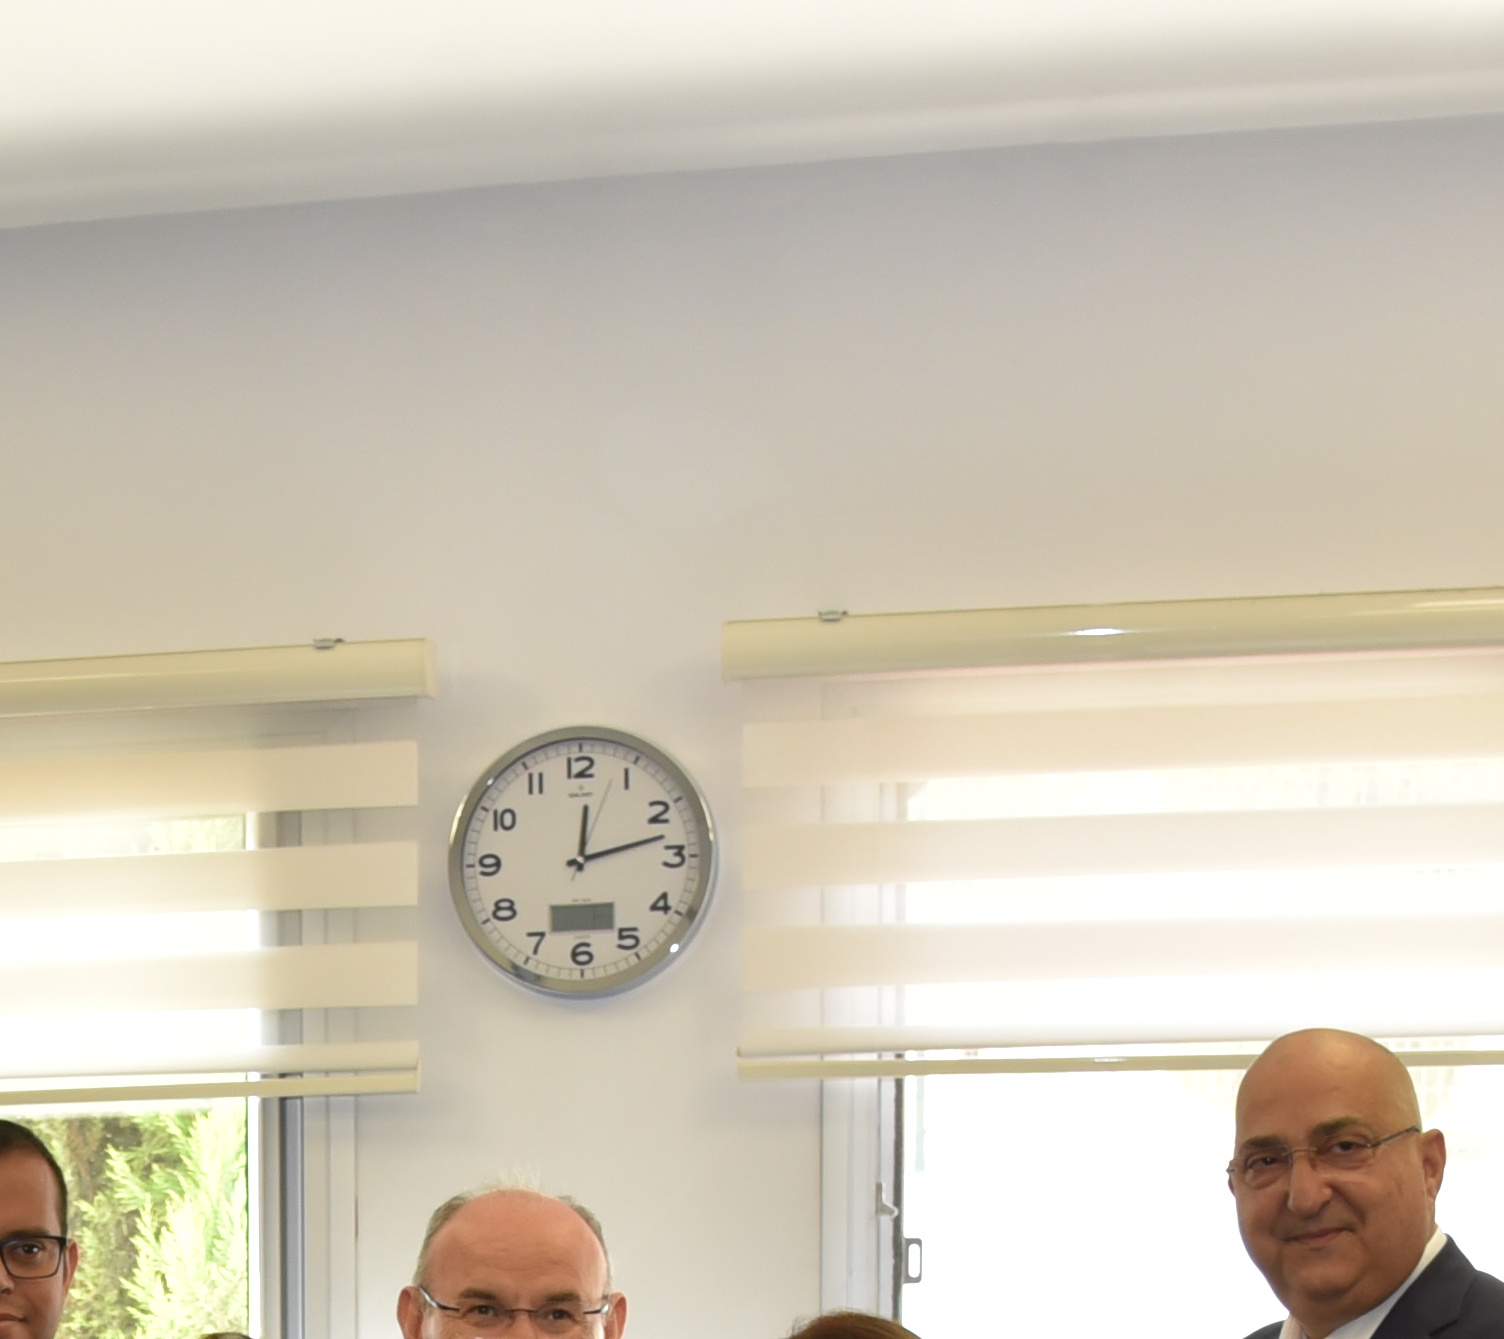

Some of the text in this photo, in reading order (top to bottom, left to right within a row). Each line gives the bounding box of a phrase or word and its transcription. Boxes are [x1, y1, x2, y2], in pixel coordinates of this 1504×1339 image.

[567, 756, 595, 780] 12
[528, 772, 543, 795] 11
[493, 808, 517, 832] 10
[647, 801, 670, 824] 2
[478, 854, 502, 877] 9
[662, 845, 686, 868] 3
[492, 898, 517, 922] 8
[649, 891, 672, 915] 4
[526, 931, 546, 955] 7
[617, 927, 640, 951] 5
[570, 942, 594, 966] 6
